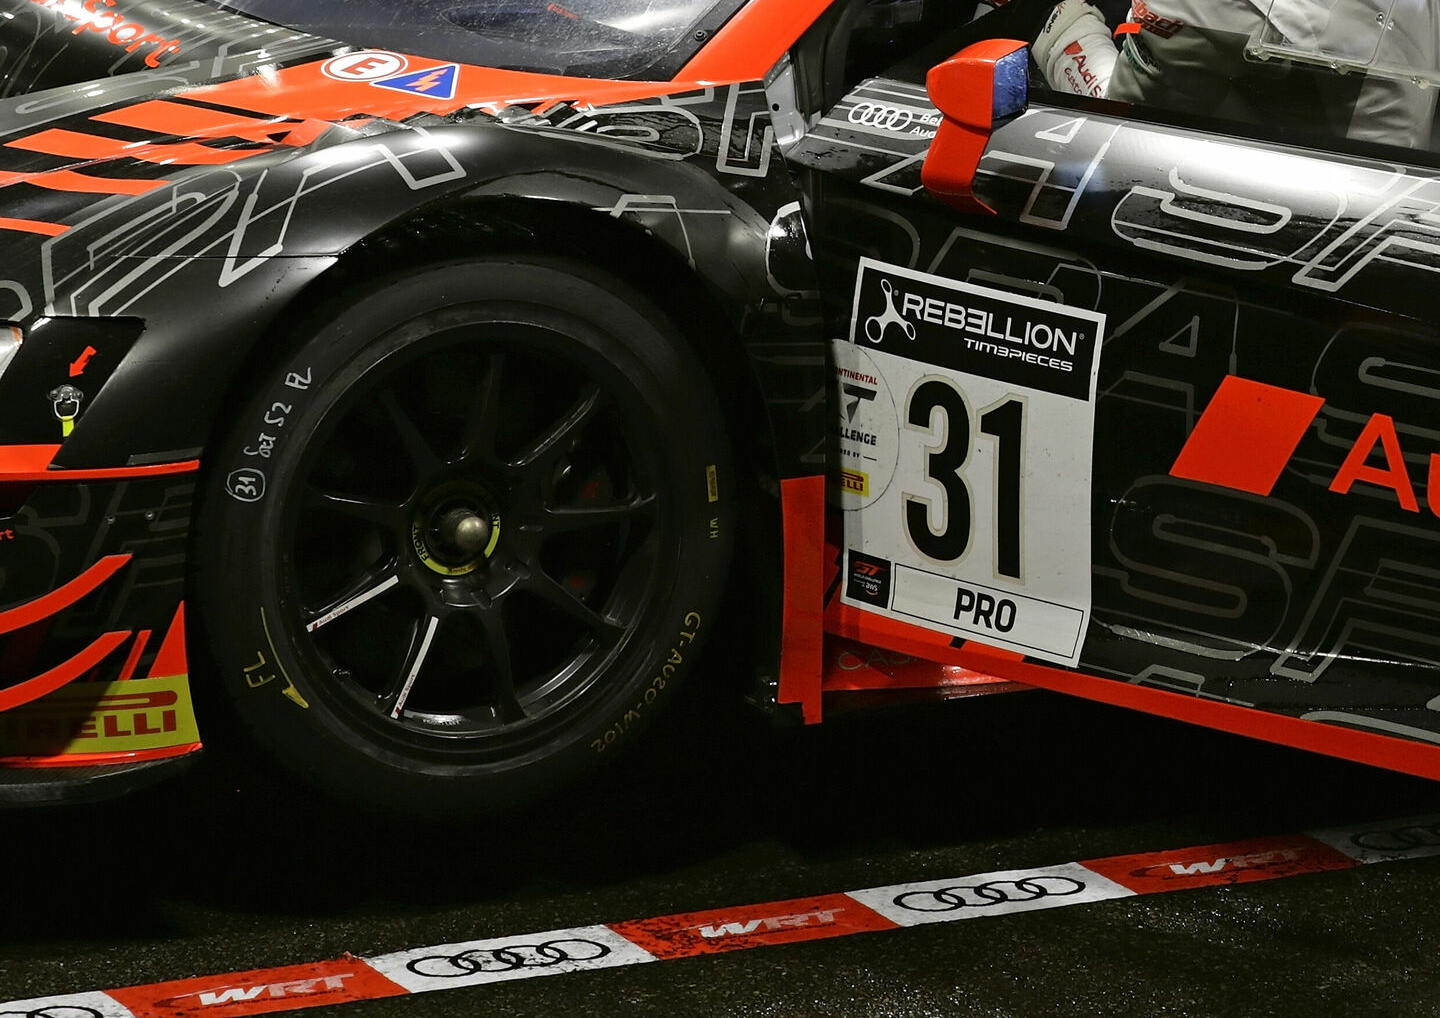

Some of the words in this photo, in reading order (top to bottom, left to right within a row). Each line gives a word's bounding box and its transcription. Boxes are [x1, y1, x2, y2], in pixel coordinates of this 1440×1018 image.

[1071, 55, 1099, 89] Audi
[902, 292, 1078, 356] REBELLION
[905, 378, 1025, 580] 31
[953, 586, 1017, 633] PRO
[699, 907, 845, 939] WRT
[199, 972, 355, 1007] WRT
